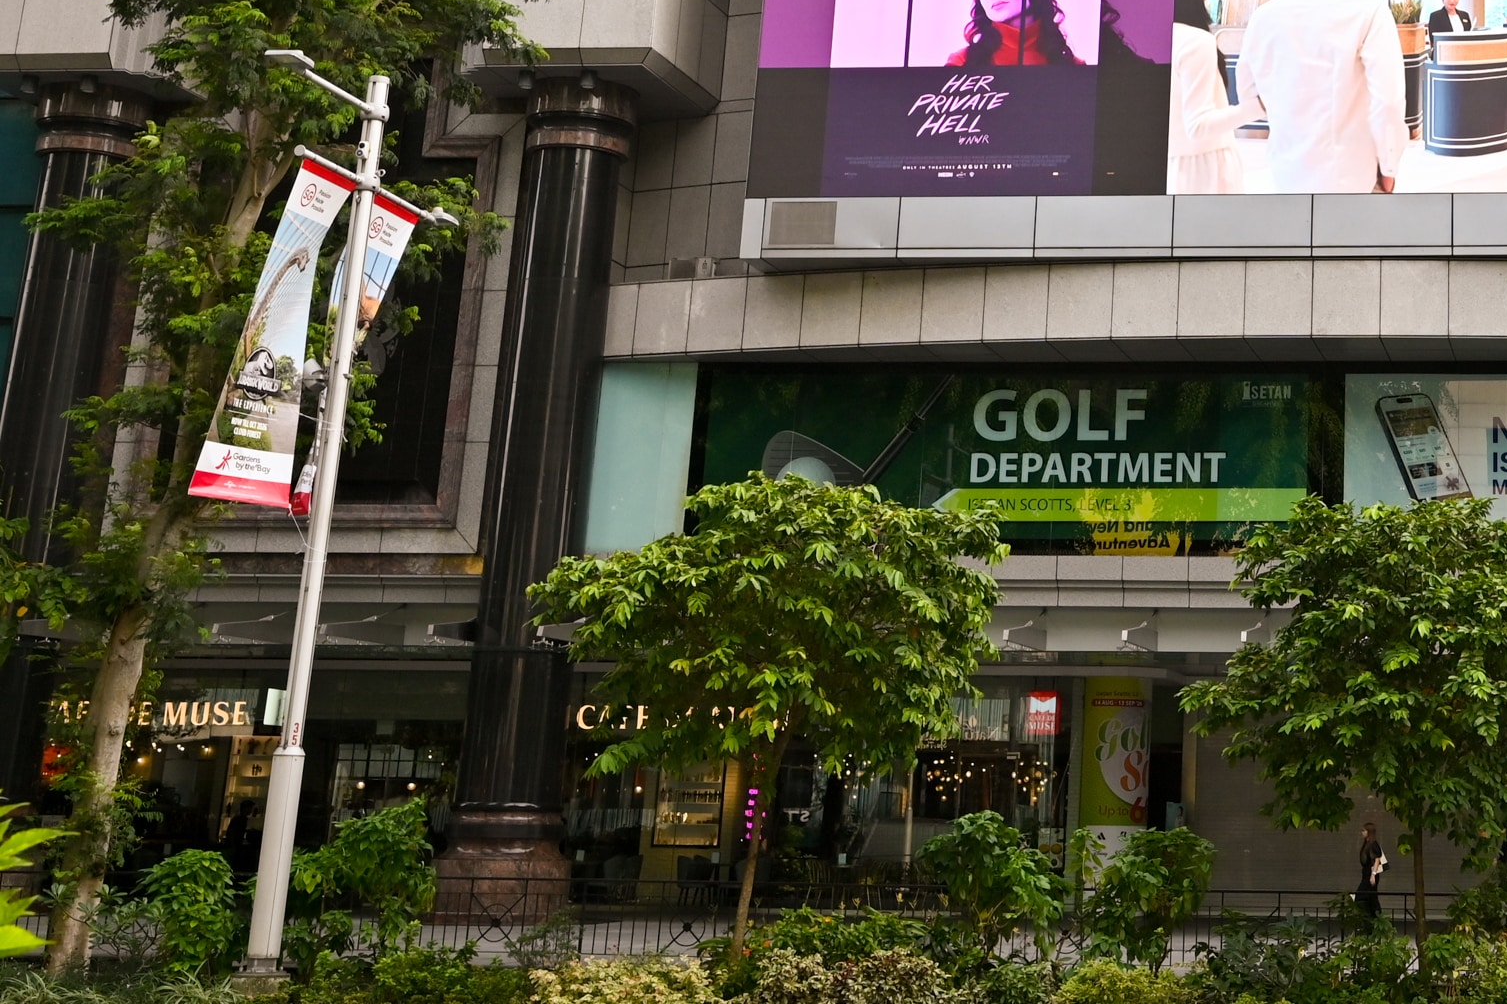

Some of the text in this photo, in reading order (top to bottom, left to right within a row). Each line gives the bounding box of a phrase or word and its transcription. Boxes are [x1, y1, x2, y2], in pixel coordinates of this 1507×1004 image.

[941, 74, 995, 94] HER
[907, 92, 1010, 116] PRIVATE
[916, 113, 981, 137] HELL
[303, 189, 314, 201] SG
[370, 222, 381, 233] SG
[1242, 381, 1292, 401] ISETAN
[973, 389, 1148, 442] GOLF
[233, 453, 261, 463] Gardens
[969, 452, 1227, 483] DEPARTMENT
[235, 463, 271, 474] by the Bay
[1020, 498, 1075, 513] SCOTTS,
[1080, 498, 1119, 511] LEVEL
[1125, 499, 1132, 511] 3
[163, 701, 250, 726] MUSE
[1029, 721, 1056, 730] MUSE
